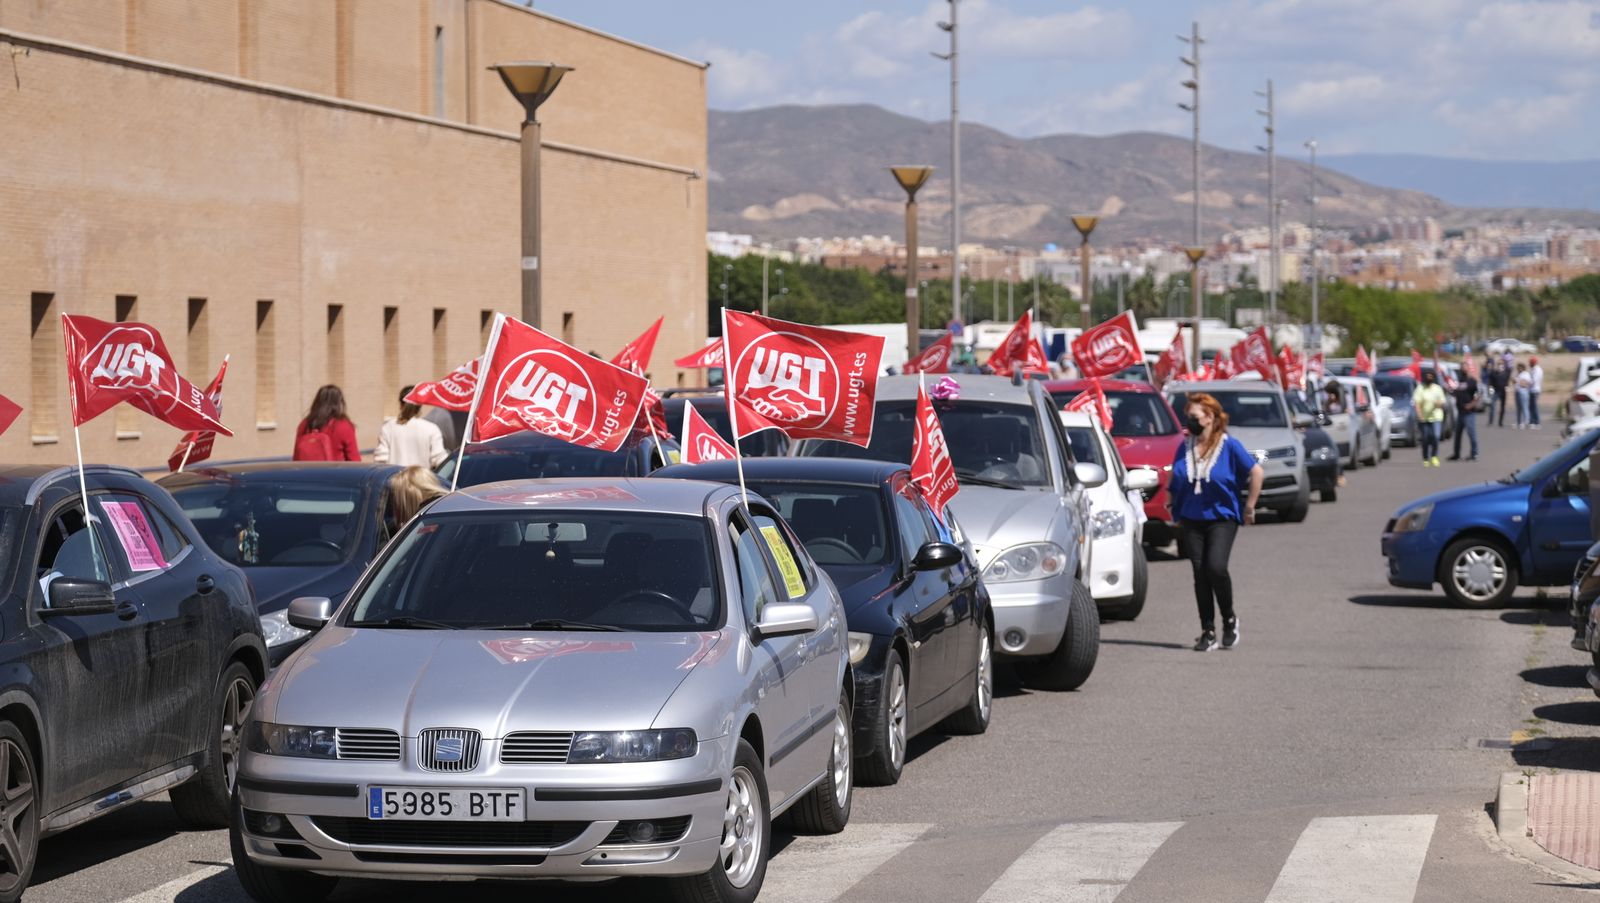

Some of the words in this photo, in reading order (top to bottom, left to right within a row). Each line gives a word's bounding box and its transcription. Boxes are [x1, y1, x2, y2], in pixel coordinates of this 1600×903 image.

[92, 342, 166, 386] UGT
[749, 346, 827, 399] UGT
[508, 359, 588, 424] UGT
[384, 791, 453, 816] 5985
[468, 792, 520, 818] BTF
